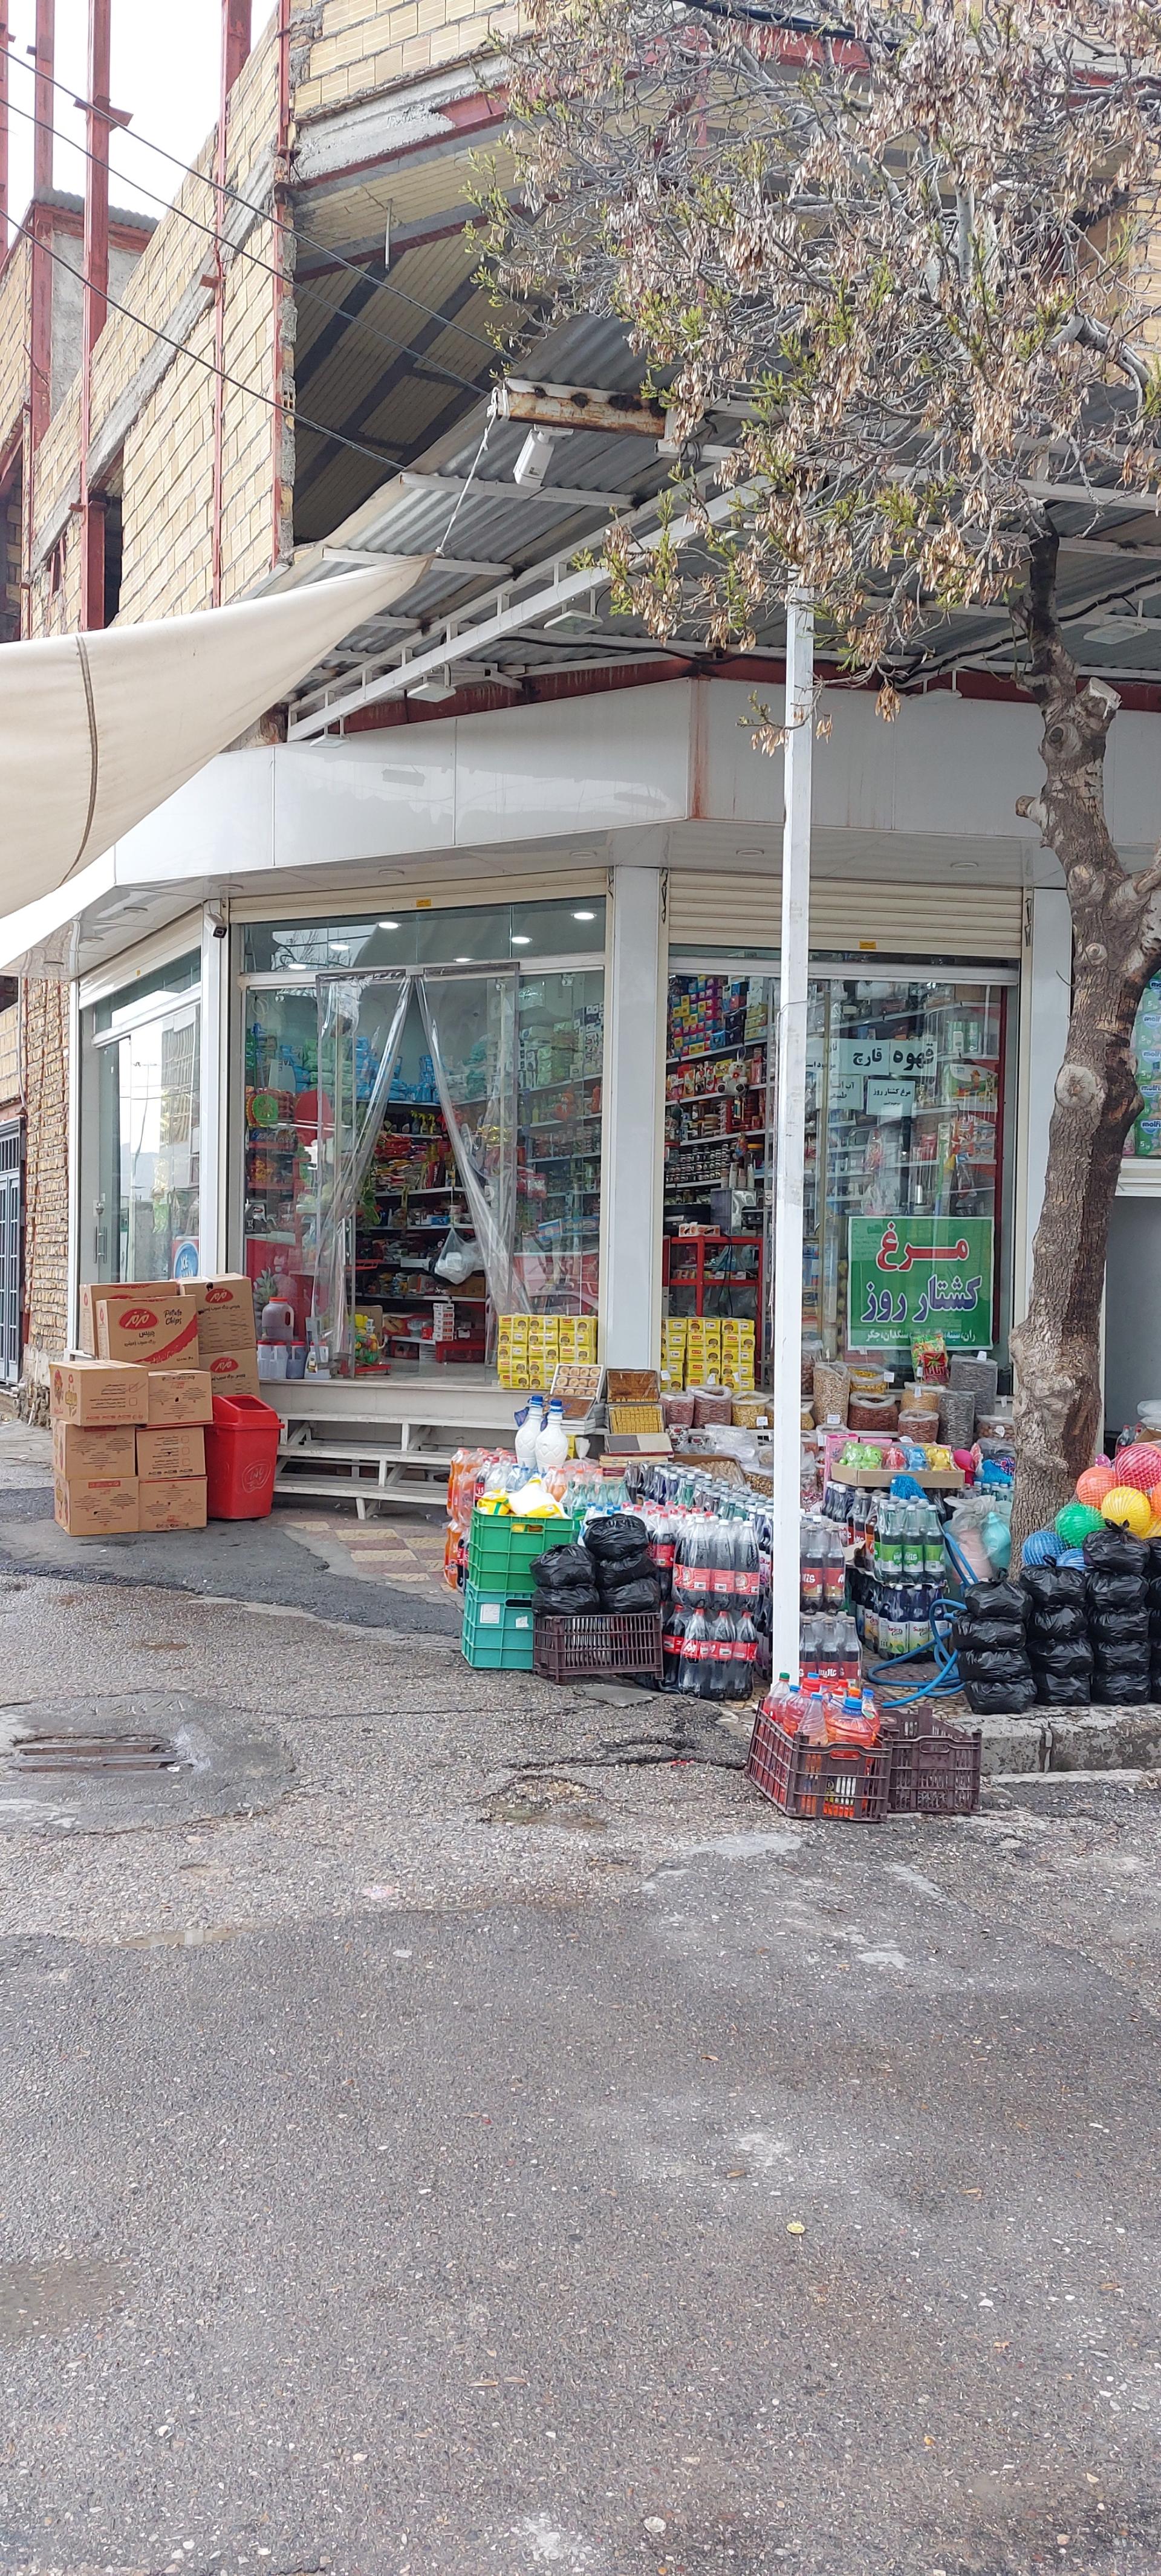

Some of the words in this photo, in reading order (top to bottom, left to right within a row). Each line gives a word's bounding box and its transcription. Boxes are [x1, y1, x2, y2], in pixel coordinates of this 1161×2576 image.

[853, 1047, 882, 1067] قارچ
[893, 1042, 934, 1071] قهوه
[884, 1087, 900, 1096] کشتار
[900, 1088, 911, 1096] مرغ
[876, 1221, 969, 1272] مرغ
[861, 1281, 907, 1322] روز
[912, 1274, 983, 1322] کشتار
[165, 1317, 183, 1325] Chips
